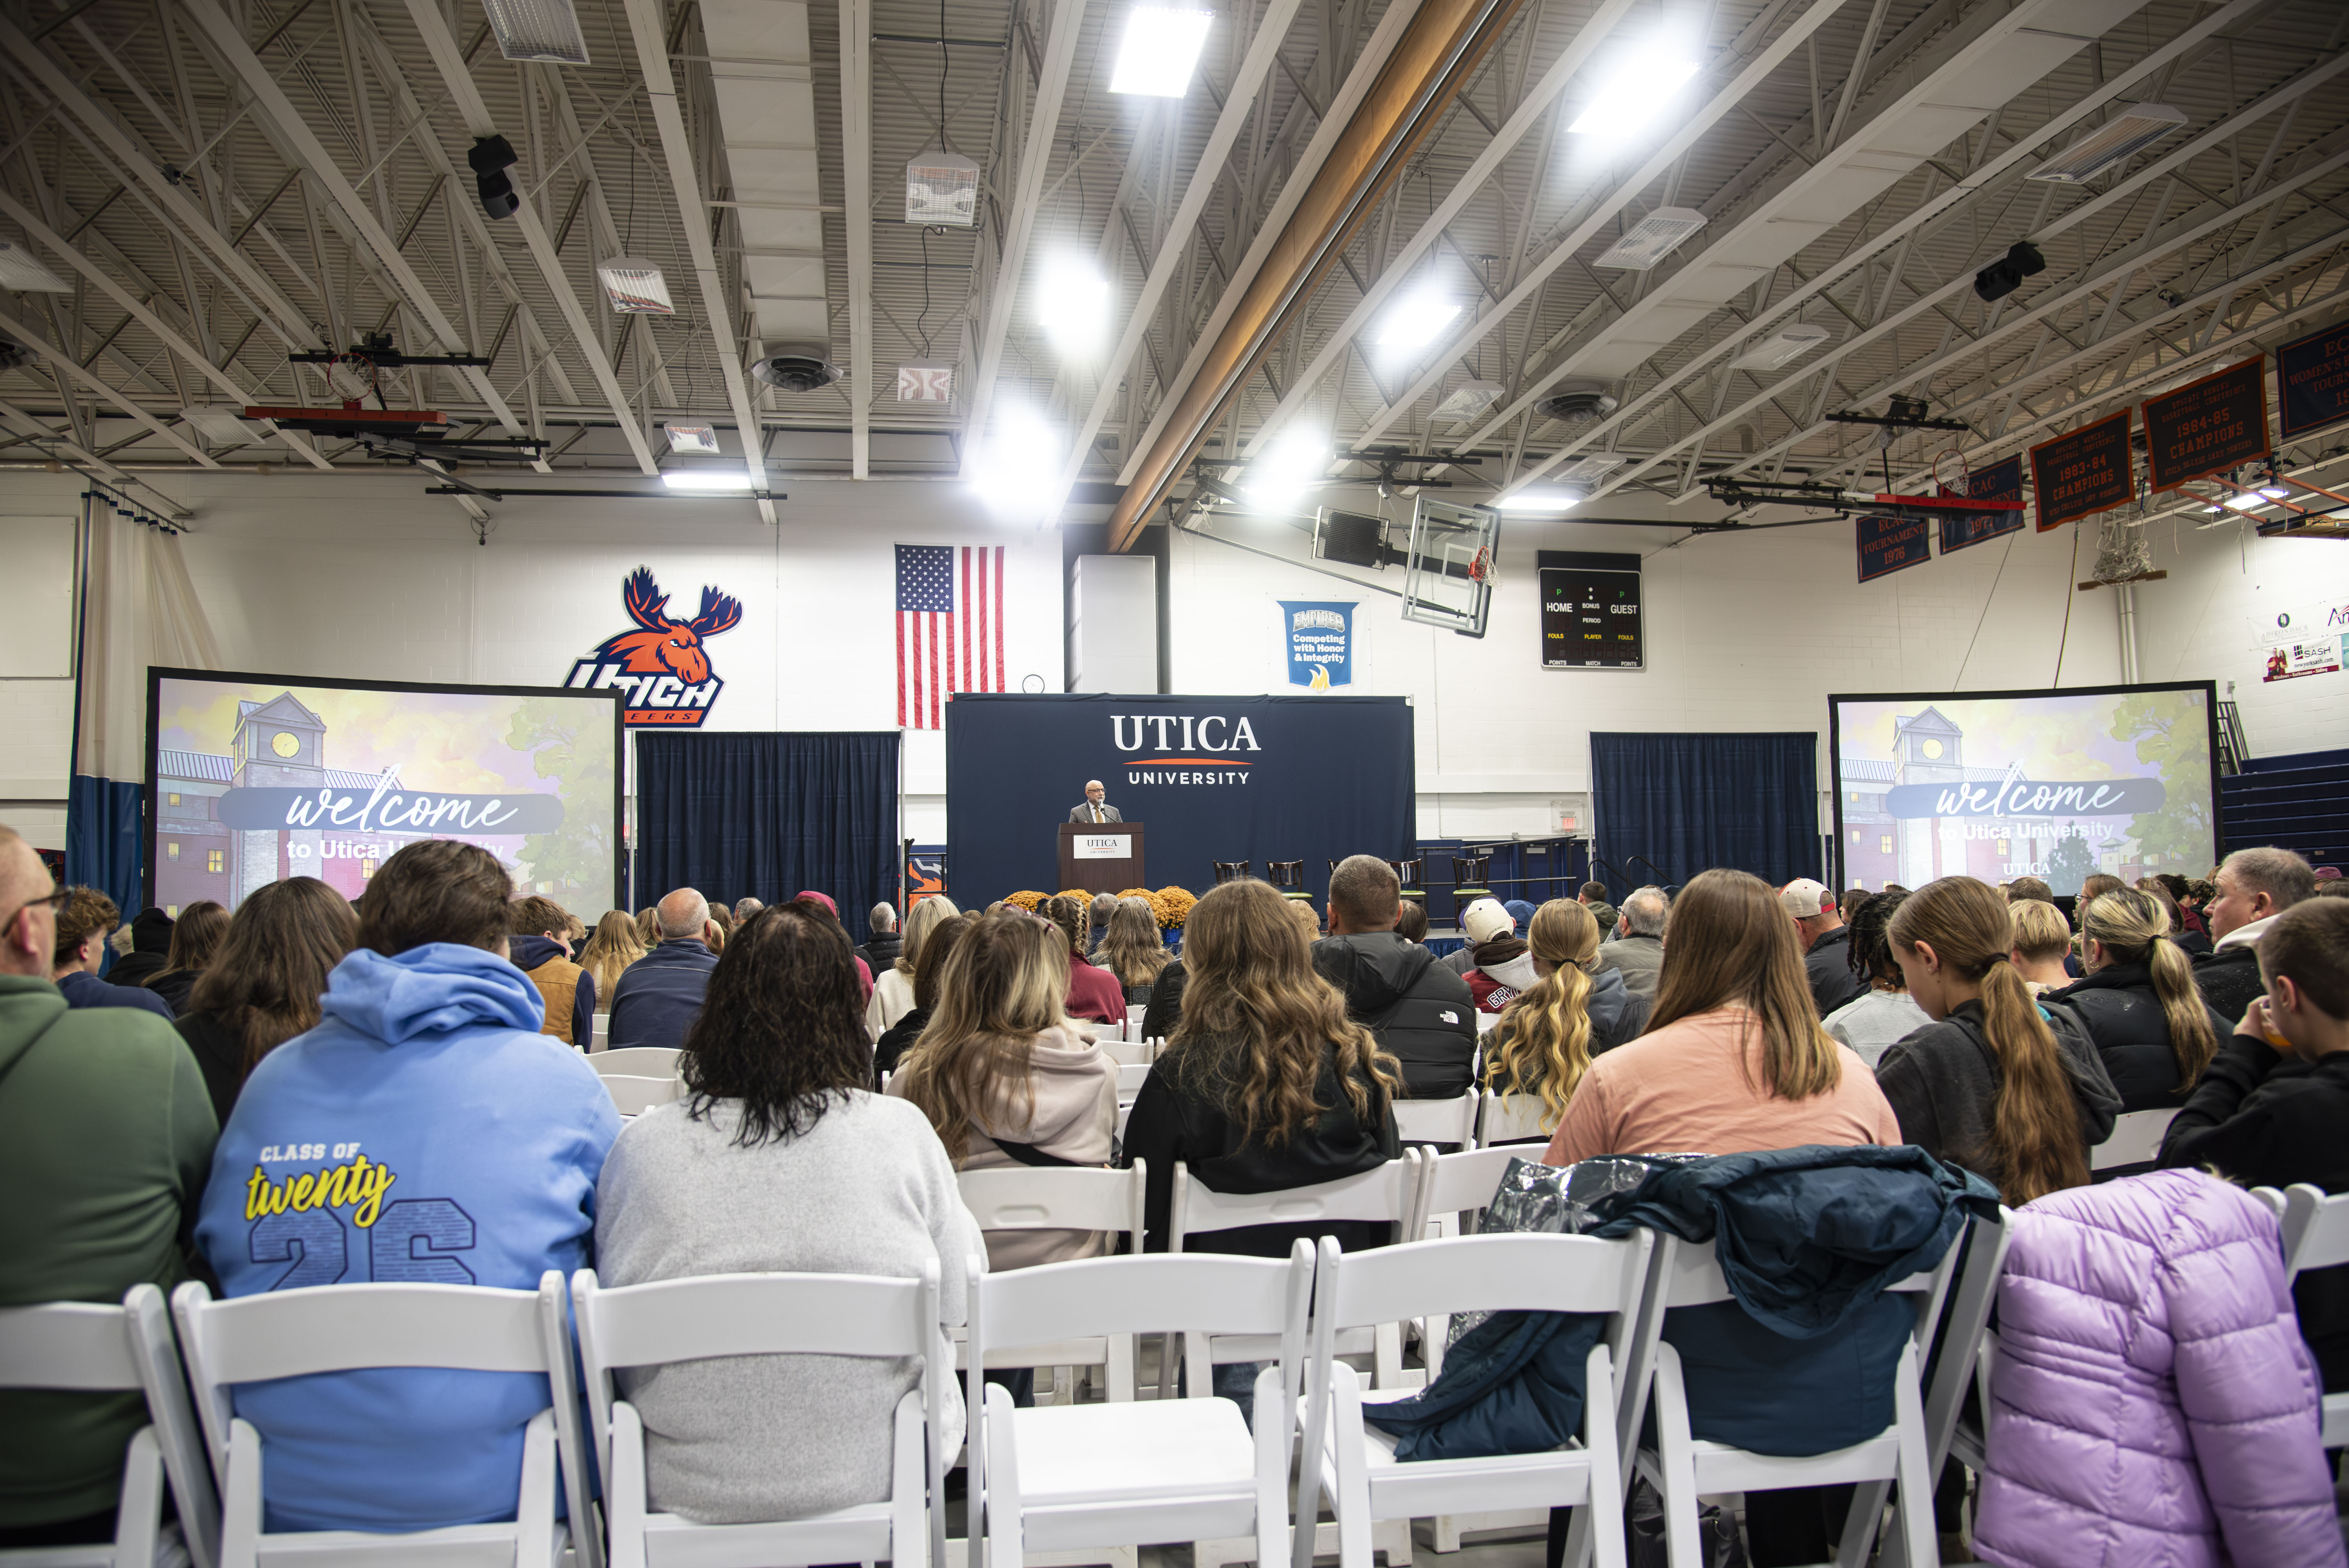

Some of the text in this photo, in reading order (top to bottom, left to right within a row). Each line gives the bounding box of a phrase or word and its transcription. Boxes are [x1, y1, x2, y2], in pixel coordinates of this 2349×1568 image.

[2289, 358, 2342, 386] WOMEN'S
[2177, 407, 2230, 438] 1984-85
[2169, 421, 2244, 459] CHAMPIONS
[2060, 453, 2107, 481] 1983-84
[2053, 469, 2114, 501] CHAMPIONS
[1863, 523, 1925, 555] TOURNAMENT
[1884, 546, 1905, 565] 1976
[1547, 602, 1573, 612] HOME
[1611, 604, 1637, 614] GUEST
[1293, 634, 1345, 645] Competing
[2261, 624, 2309, 638] ADIRONDACK
[1294, 643, 1345, 652] with Honor
[2304, 646, 2331, 658] SASH
[1294, 653, 1345, 664] & Integrity
[2294, 657, 2333, 668] newyorksash.com
[1110, 715, 1262, 752] UTICA
[1128, 772, 1249, 785] UNIVERSITY
[1936, 759, 2125, 818] welcome
[285, 763, 519, 832] welcome
[1938, 821, 2114, 841] to Utica University
[287, 840, 311, 858] to
[319, 840, 380, 859] Utica
[2003, 862, 2052, 875] UTICA
[260, 1142, 361, 1163] CLASS OF
[245, 1154, 396, 1228] twenty
